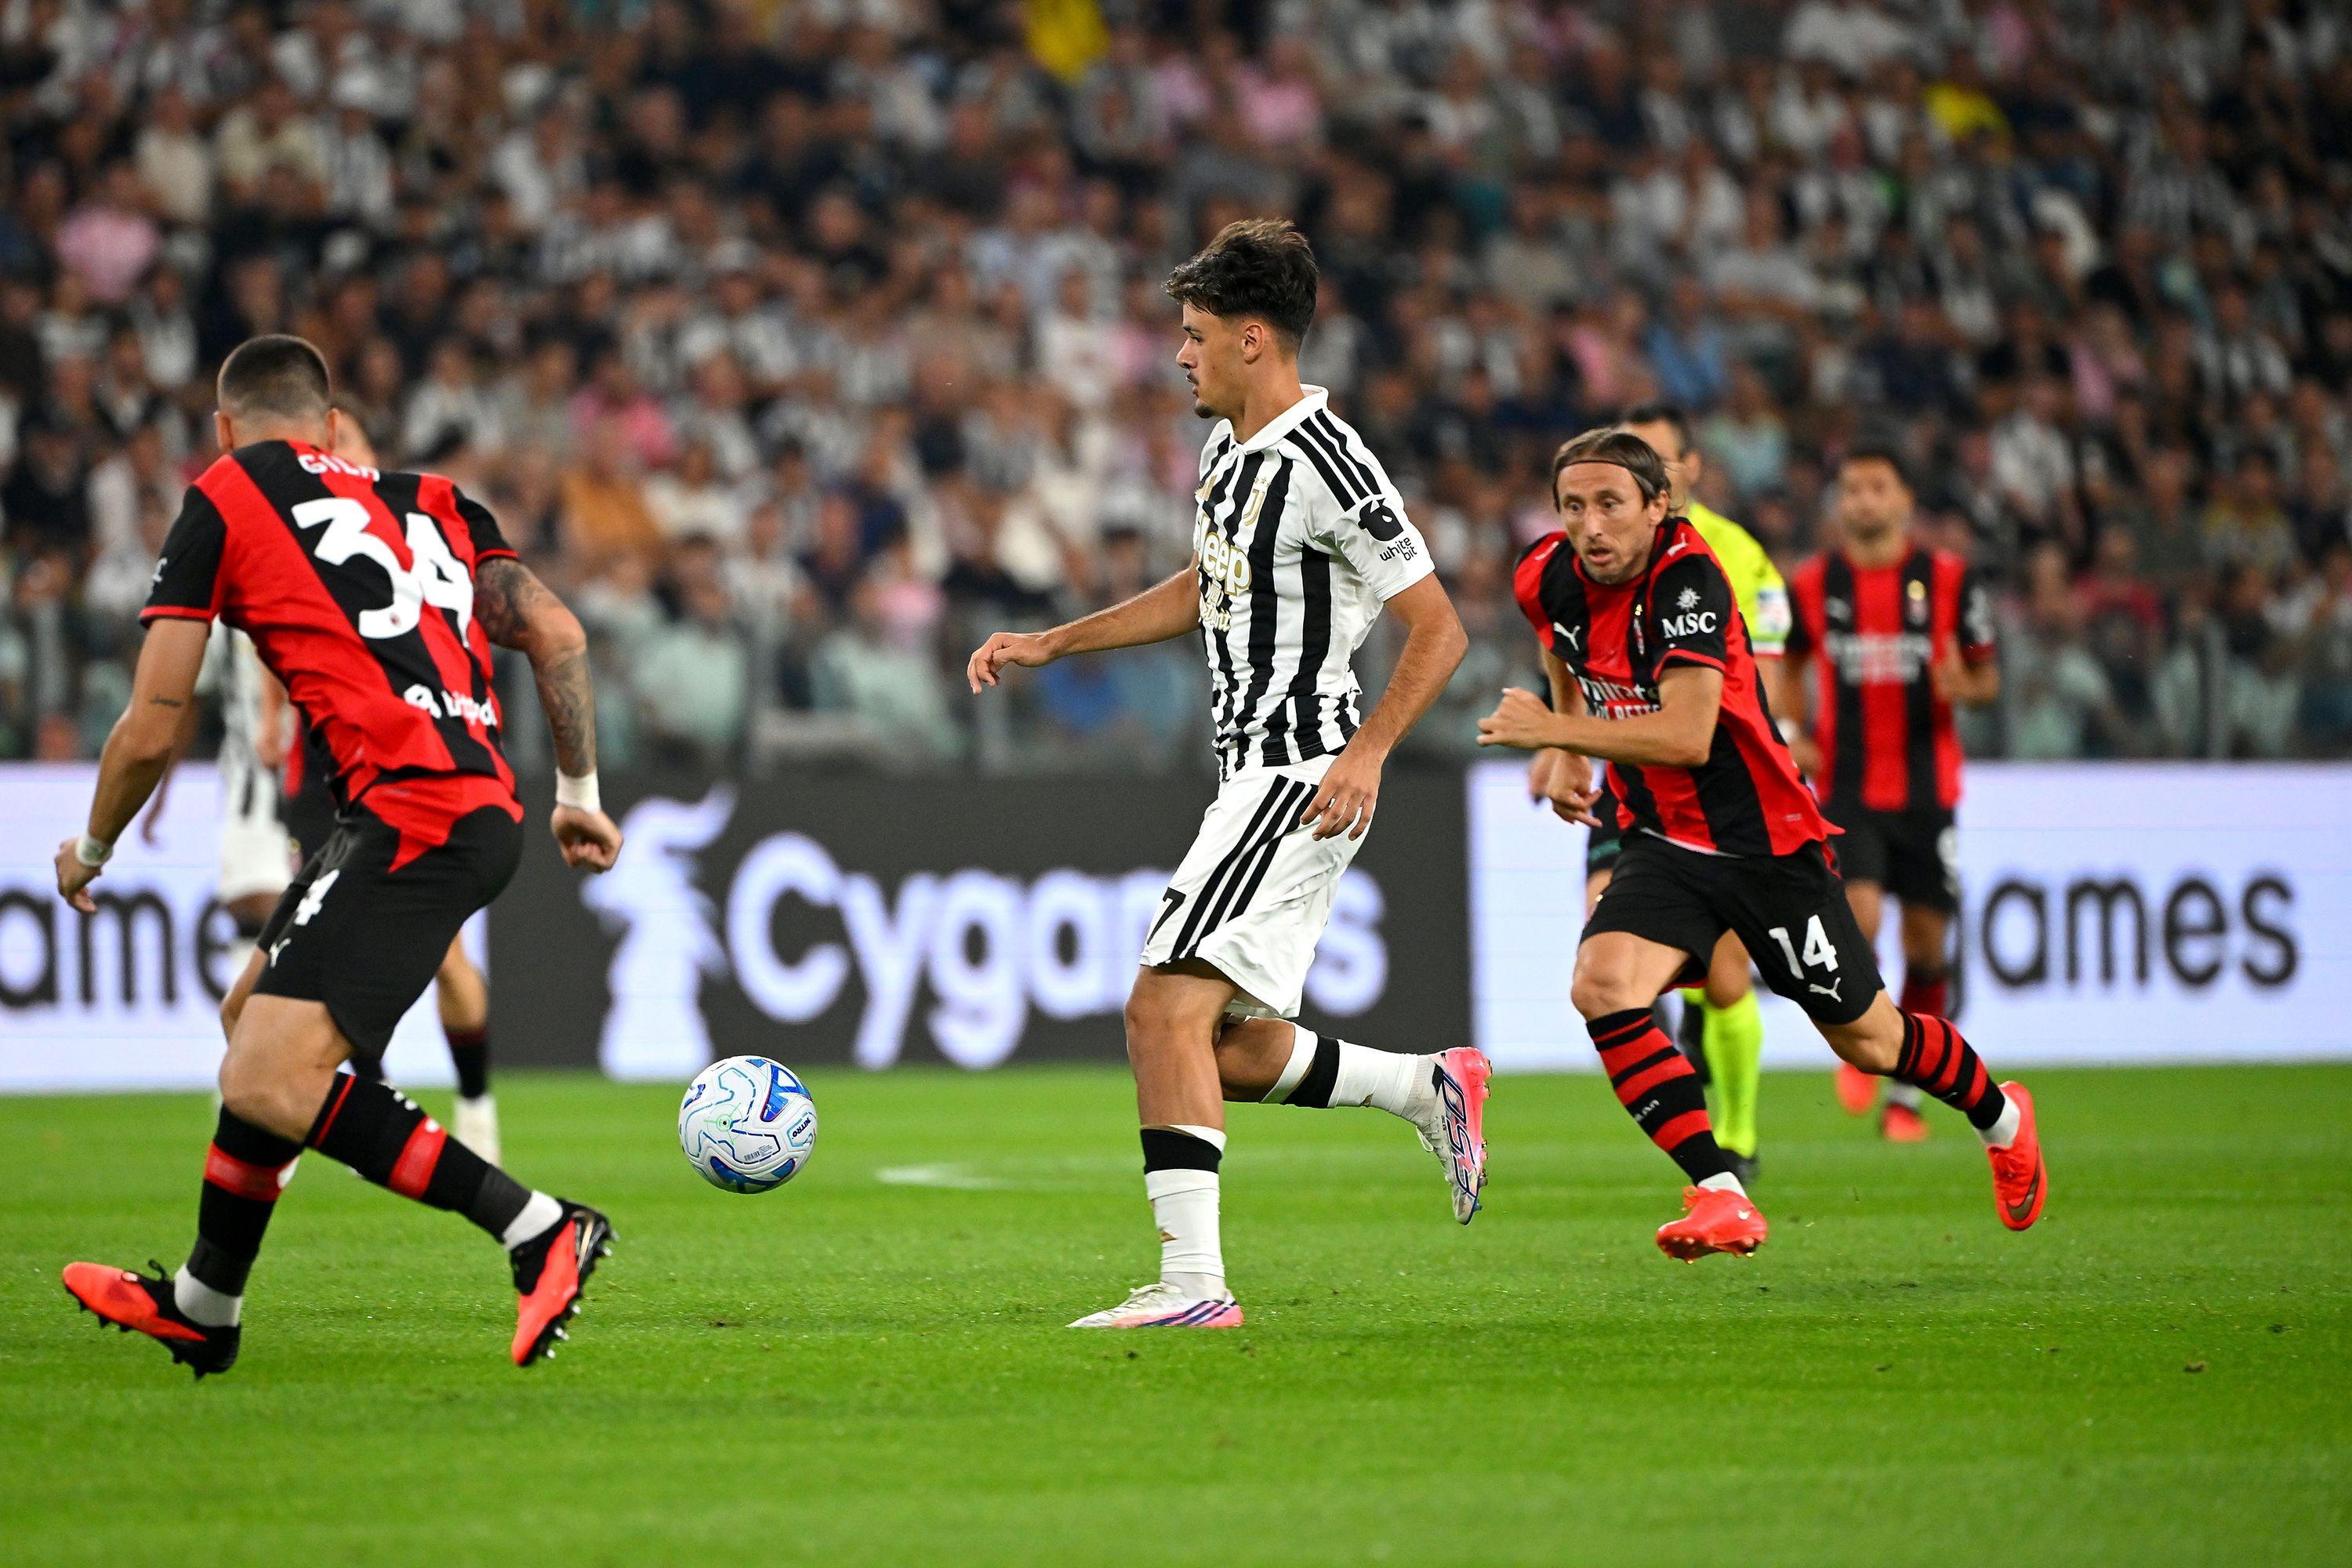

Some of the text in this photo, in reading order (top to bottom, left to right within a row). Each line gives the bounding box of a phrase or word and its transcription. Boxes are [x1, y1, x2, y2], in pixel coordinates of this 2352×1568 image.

[291, 497, 474, 650] 34
[1379, 537, 1412, 561] white
[1396, 546, 1417, 561] bit
[1662, 612, 1717, 639] MSC
[1147, 887, 1186, 946] 7
[1769, 914, 1839, 980] 14
[728, 829, 1388, 1070] Cygas
[1443, 1073, 1477, 1200] F50
